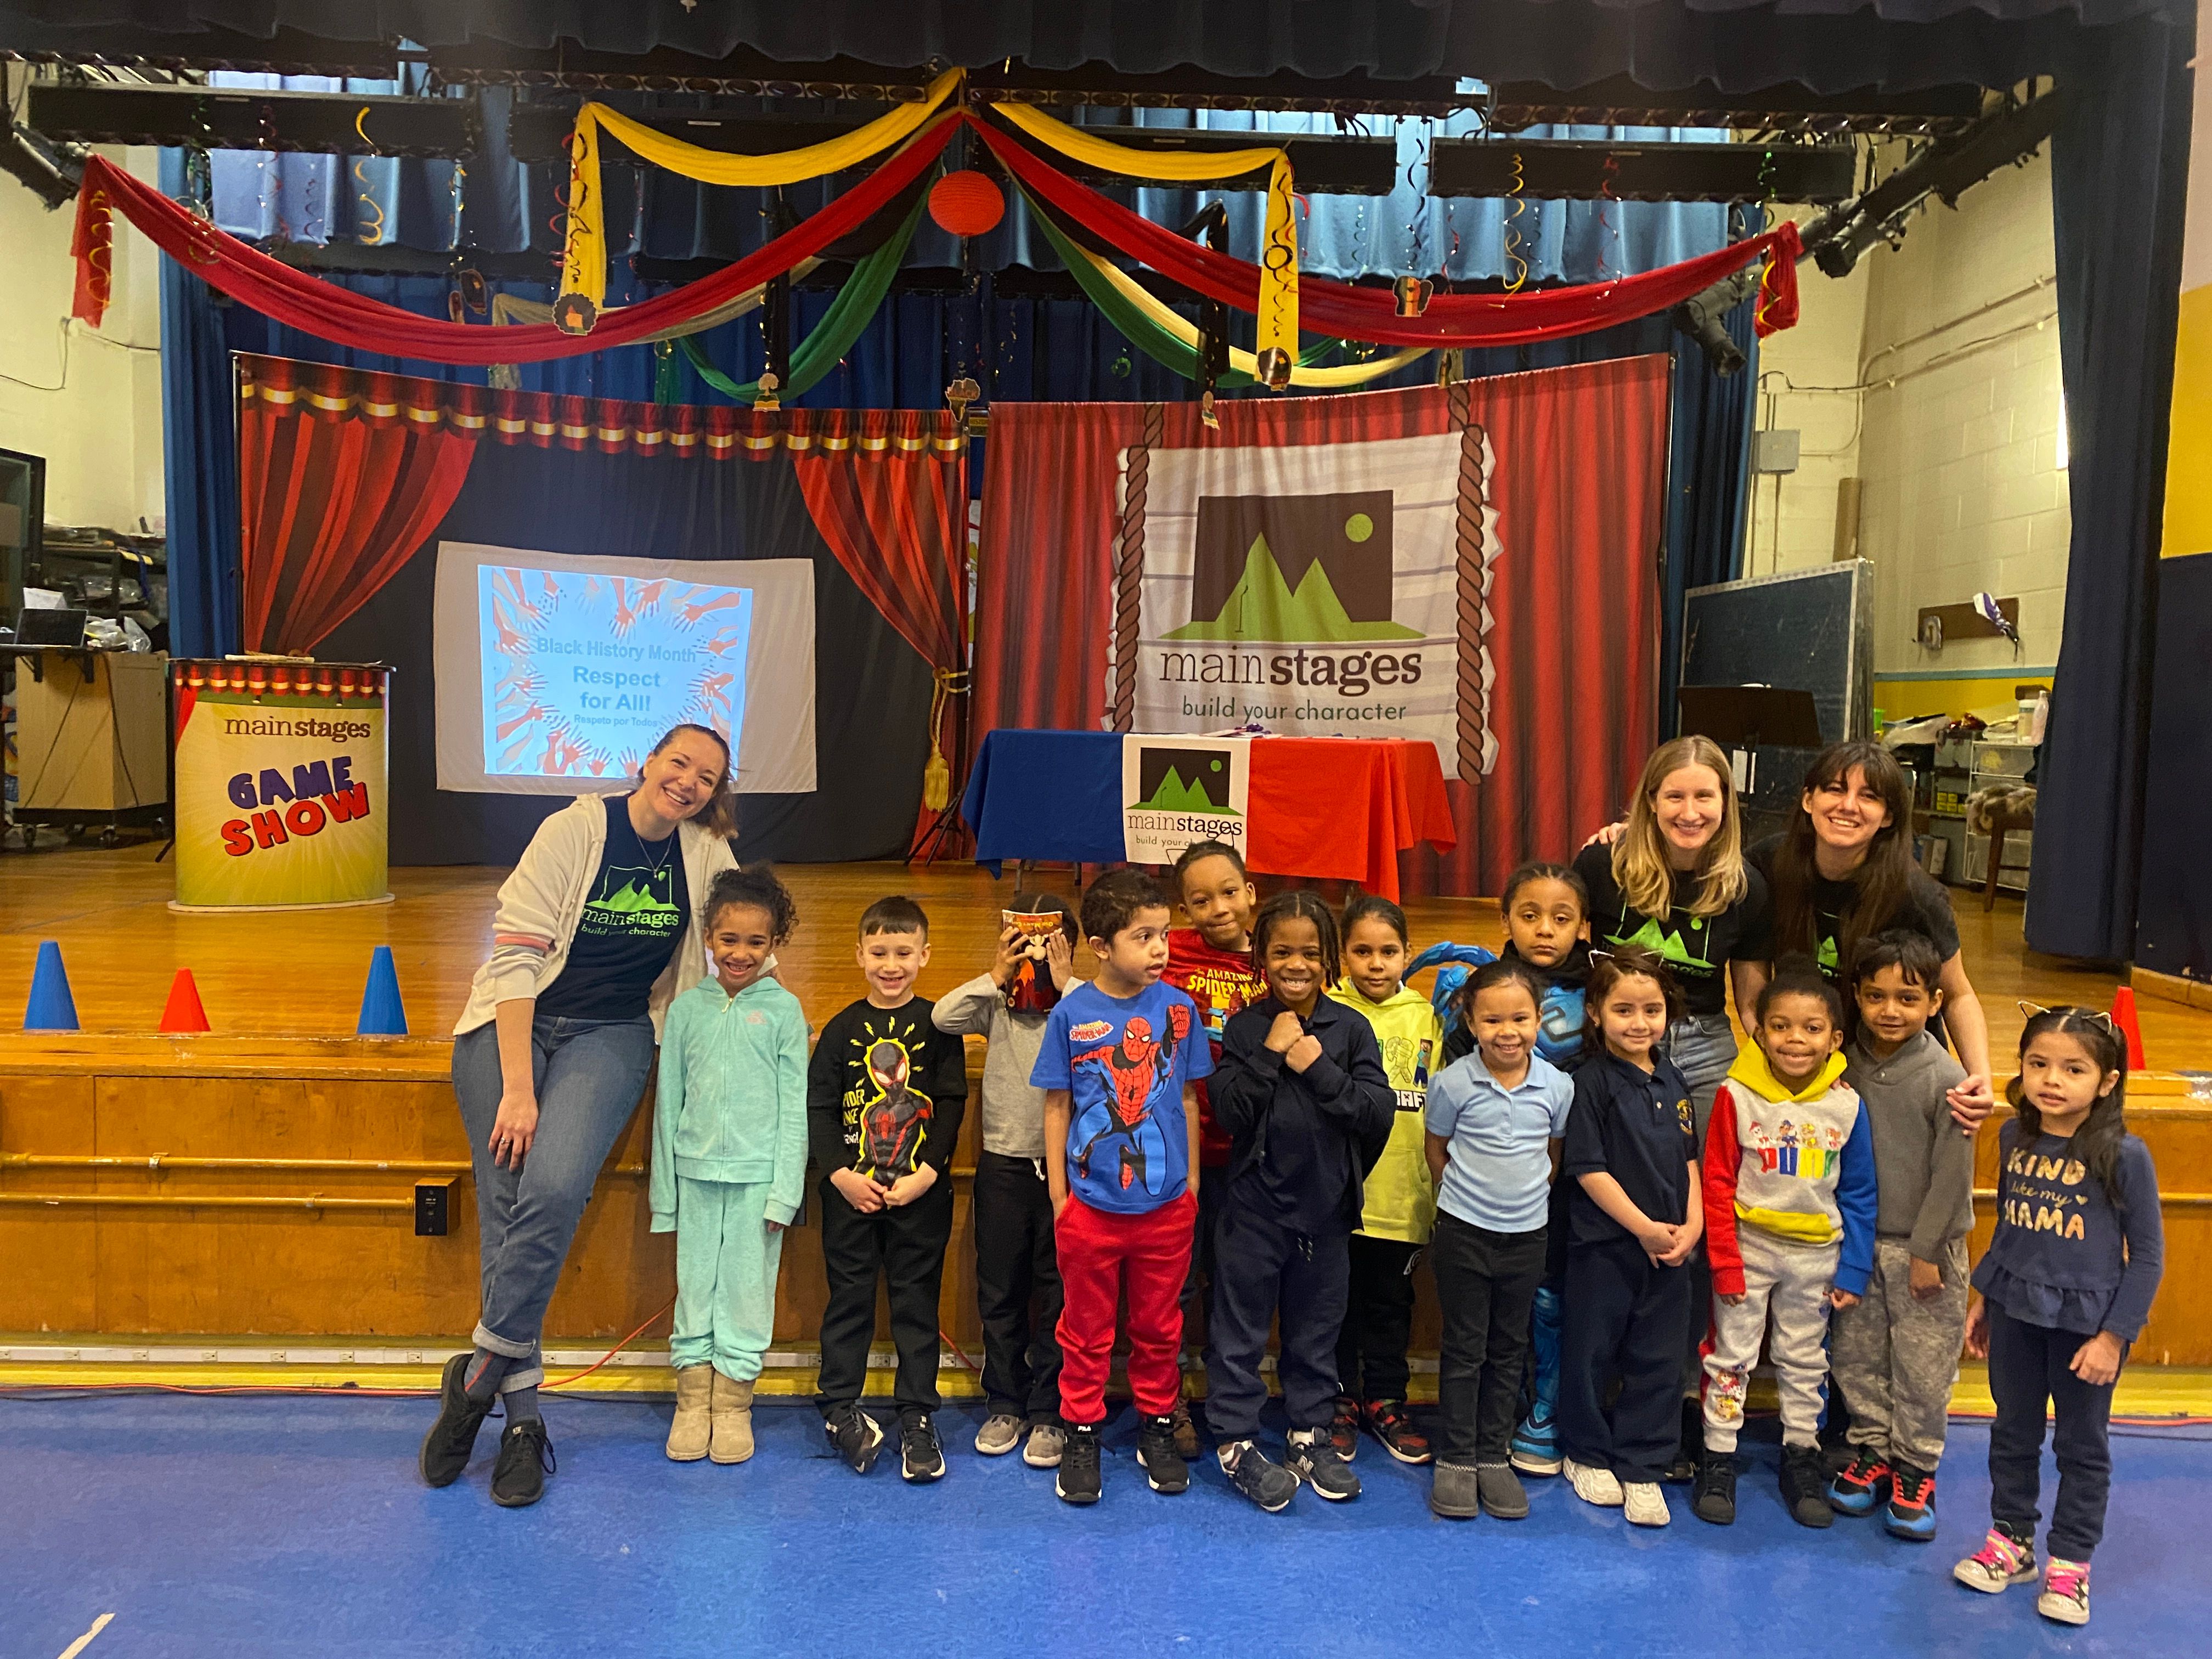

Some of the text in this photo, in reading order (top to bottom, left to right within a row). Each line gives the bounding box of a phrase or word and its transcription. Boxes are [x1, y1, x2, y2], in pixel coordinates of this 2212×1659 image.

[537, 637, 696, 663] Black History Month
[573, 665, 661, 689] Respect
[1159, 645, 1422, 697] mainstages
[580, 691, 651, 712] for All!
[1183, 696, 1407, 724] build your character
[224, 716, 371, 743] mainstages
[574, 714, 658, 727] Respeto por Todos
[228, 756, 354, 809] GAME
[221, 781, 370, 856] SHOW
[1127, 812, 1243, 839] mainstages
[1136, 834, 1157, 844] build
[581, 908, 679, 928] mainstages
[581, 924, 607, 935] build
[629, 927, 671, 937] character
[1207, 969, 1253, 981] AMAZING
[2007, 1147, 2086, 1186] KIND
[2040, 1190, 2072, 1208] my
[2005, 1199, 2085, 1240] MAMA
